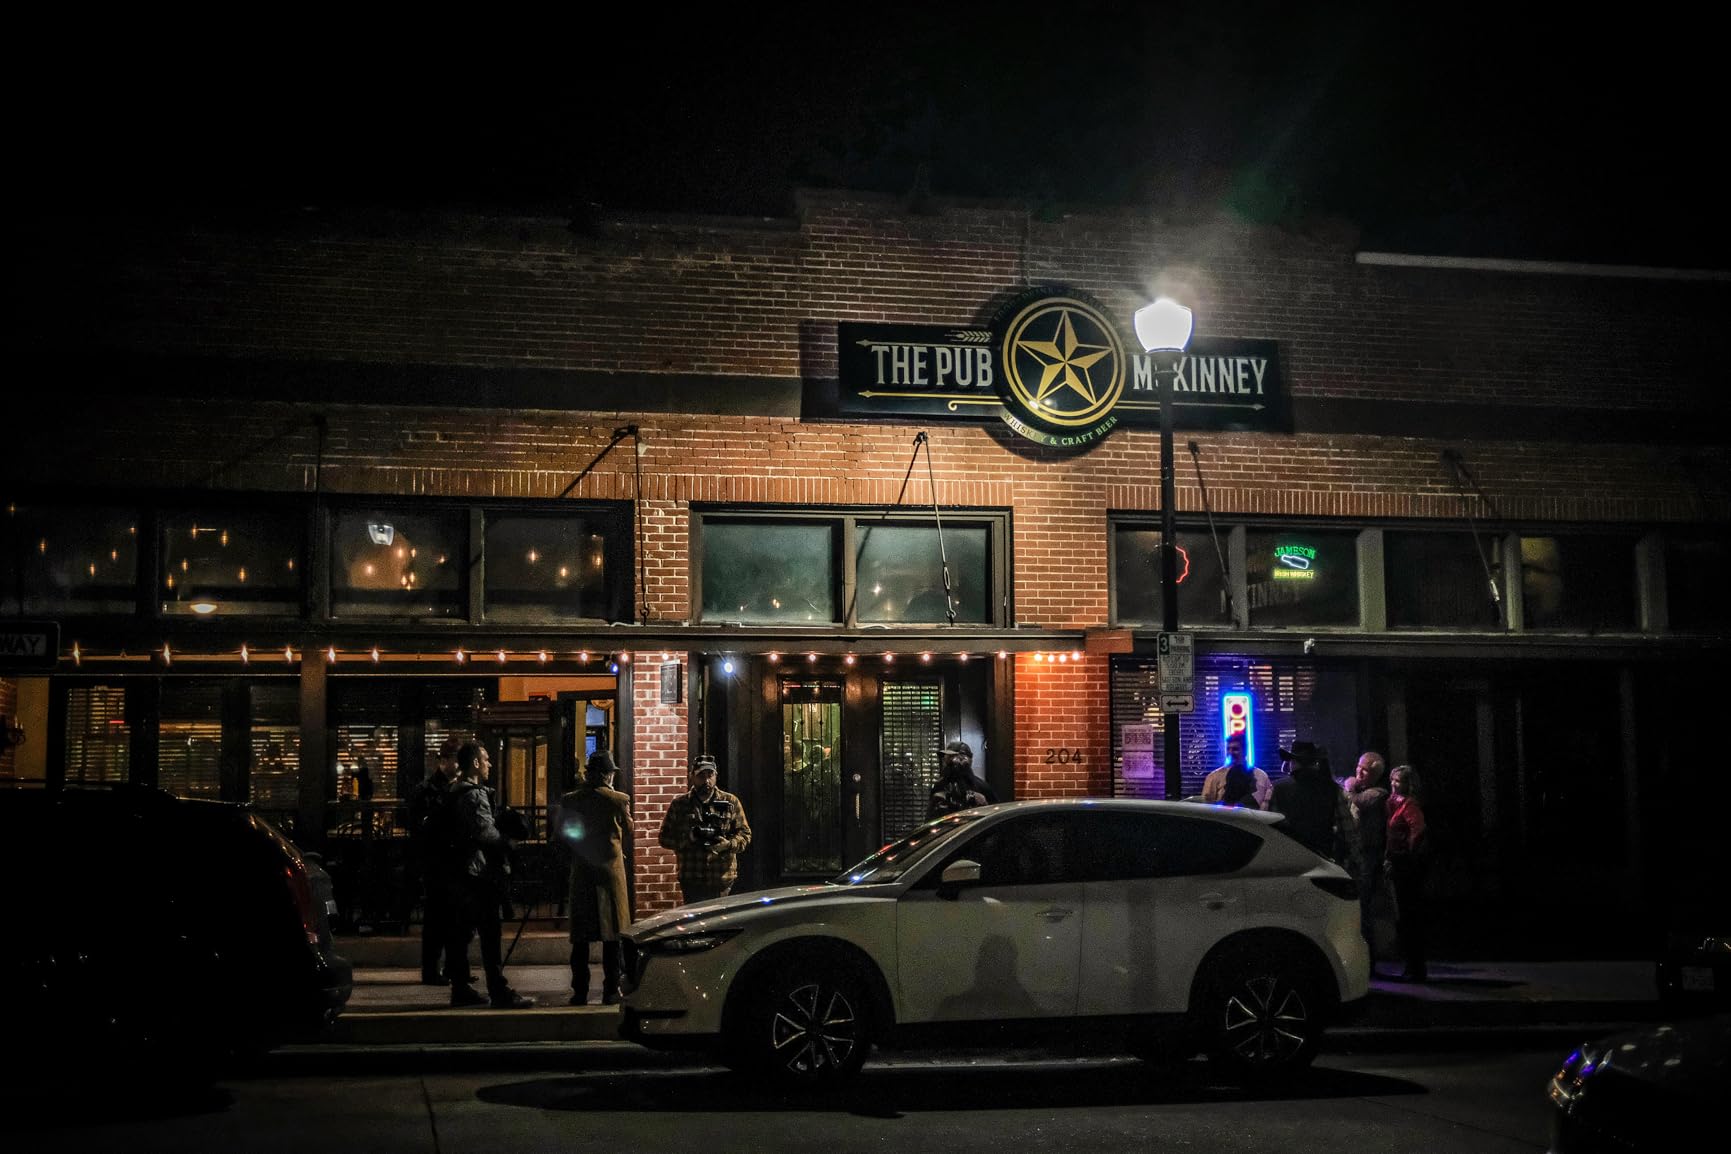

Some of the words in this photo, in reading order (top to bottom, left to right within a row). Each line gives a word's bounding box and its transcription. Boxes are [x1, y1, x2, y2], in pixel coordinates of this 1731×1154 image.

[871, 345, 928, 385] THE
[935, 347, 993, 387] PUB
[1133, 354, 1267, 394] MKINNEY
[1002, 410, 1046, 443] WHISKEY
[1049, 437, 1057, 445] &
[1061, 432, 1094, 446] CRAFT
[1095, 416, 1118, 436] BEER
[1274, 546, 1316, 559] JAMESON
[1160, 636, 1168, 652] 3
[1045, 748, 1082, 764] 204
